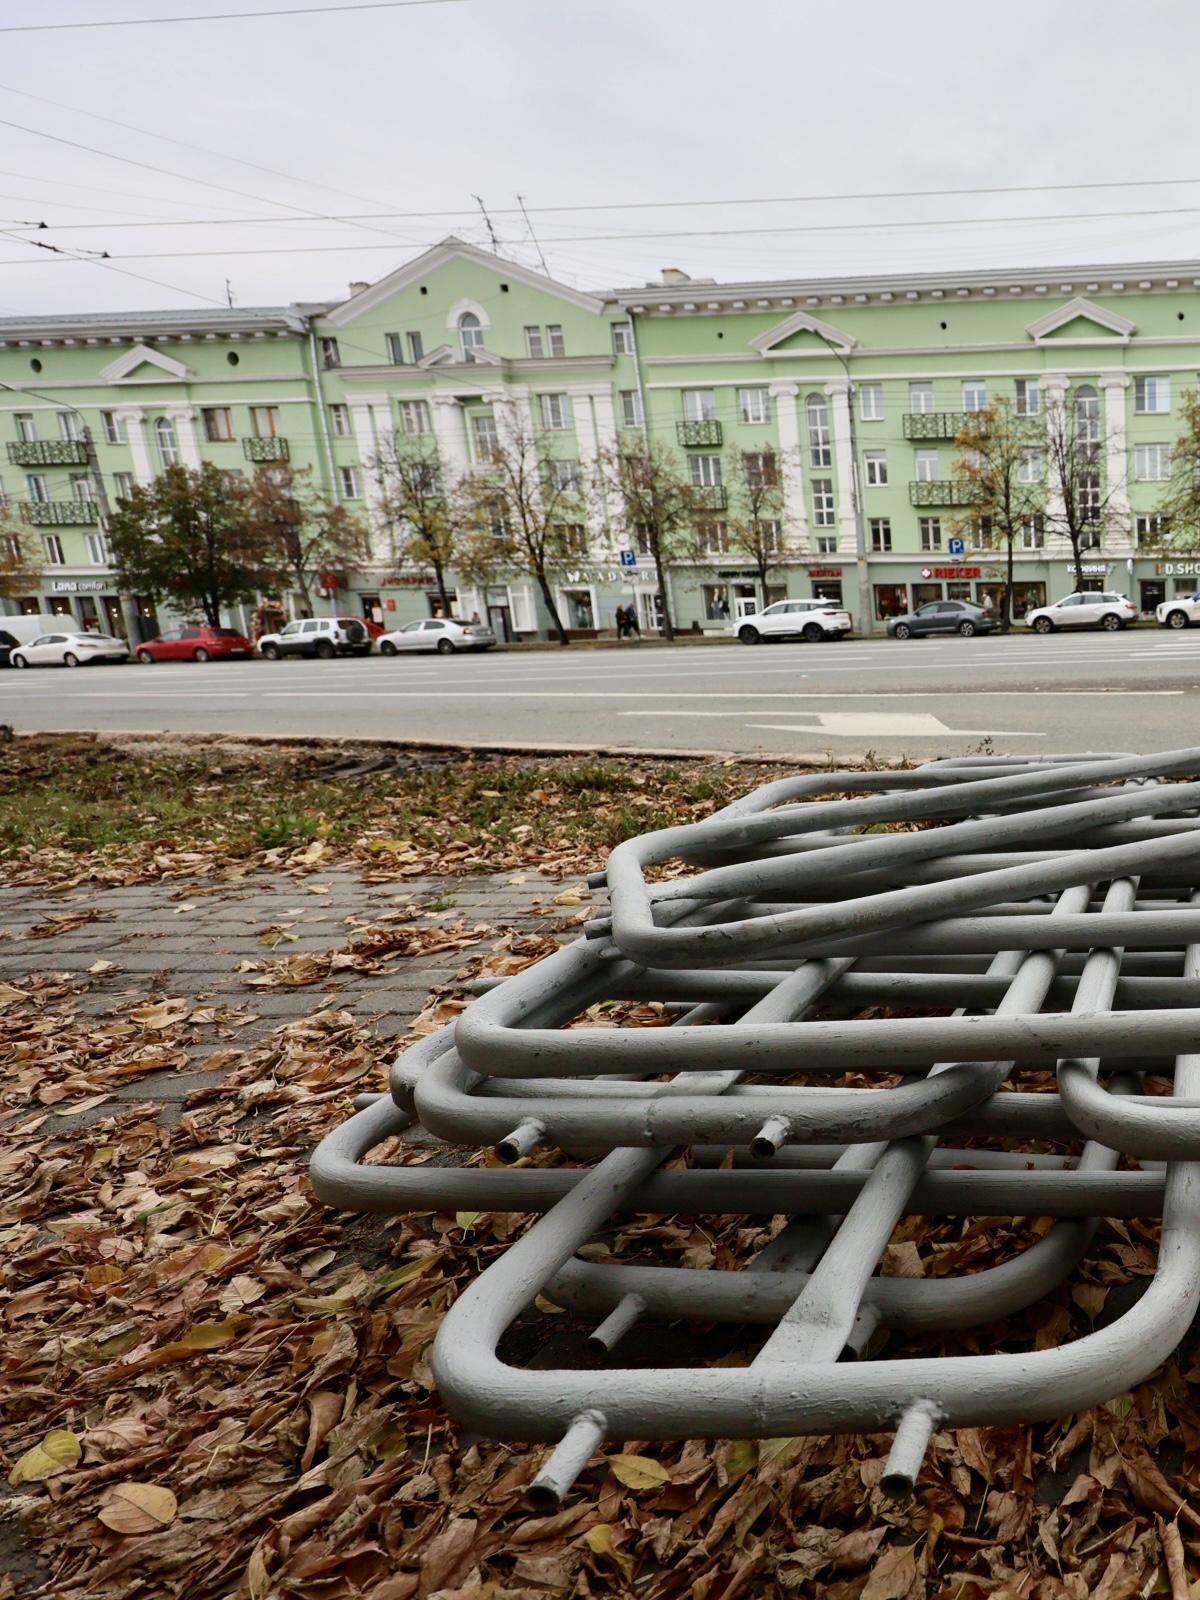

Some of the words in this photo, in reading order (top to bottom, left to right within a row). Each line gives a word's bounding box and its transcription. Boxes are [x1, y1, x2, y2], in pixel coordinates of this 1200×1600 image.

[952, 539, 962, 552] P
[623, 551, 633, 565] P
[934, 567, 981, 579] RIEKER
[52, 581, 77, 591] Lana
